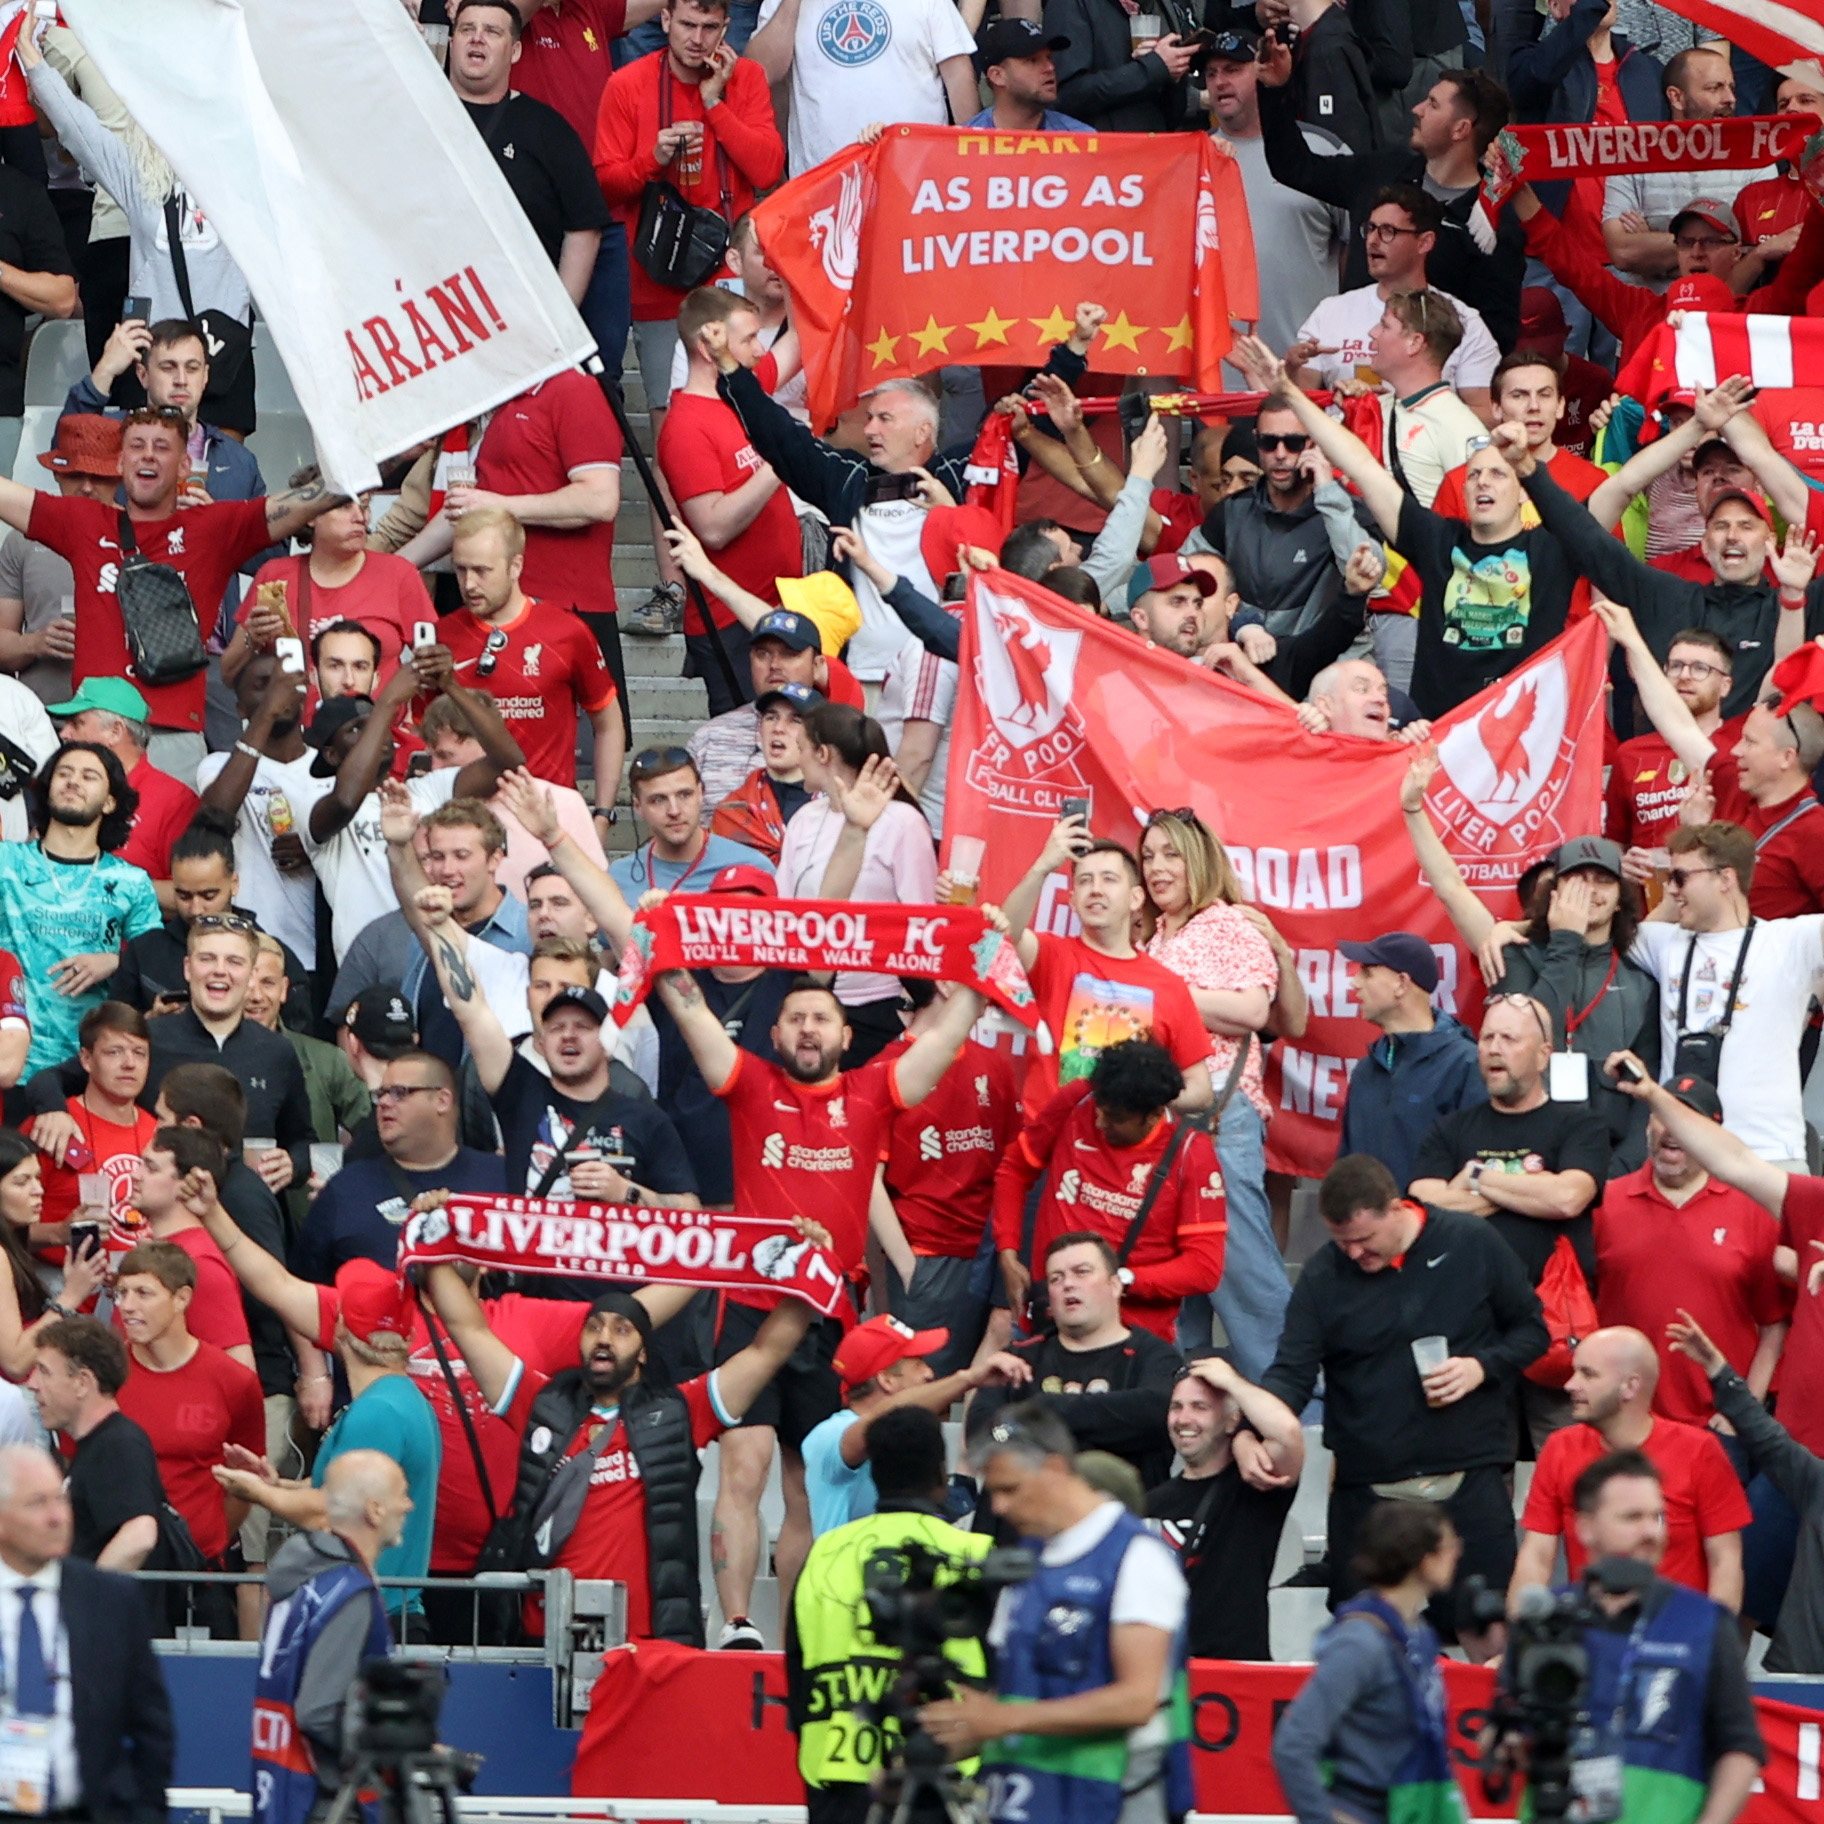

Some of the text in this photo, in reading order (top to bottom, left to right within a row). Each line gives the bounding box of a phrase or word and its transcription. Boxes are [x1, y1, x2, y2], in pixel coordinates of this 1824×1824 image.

[823, 2, 886, 41] UP THE REDS
[1545, 122, 1790, 167] LIVERPOOL FC
[912, 175, 1143, 214] AS BIG AS
[903, 228, 1152, 273] LIVERPOOL
[1433, 776, 1568, 850] LIVER POOL
[672, 905, 950, 955] LIVERPOOL FC
[680, 944, 943, 973] YOU'LL NEVER WALK ALONE
[789, 1145, 851, 1157] standard
[495, 1198, 710, 1225] KENNY DALGLISH
[1081, 1182, 1144, 1207] standard
[452, 1208, 747, 1271] LIVERPOOL
[555, 1256, 647, 1277] LEGEND
